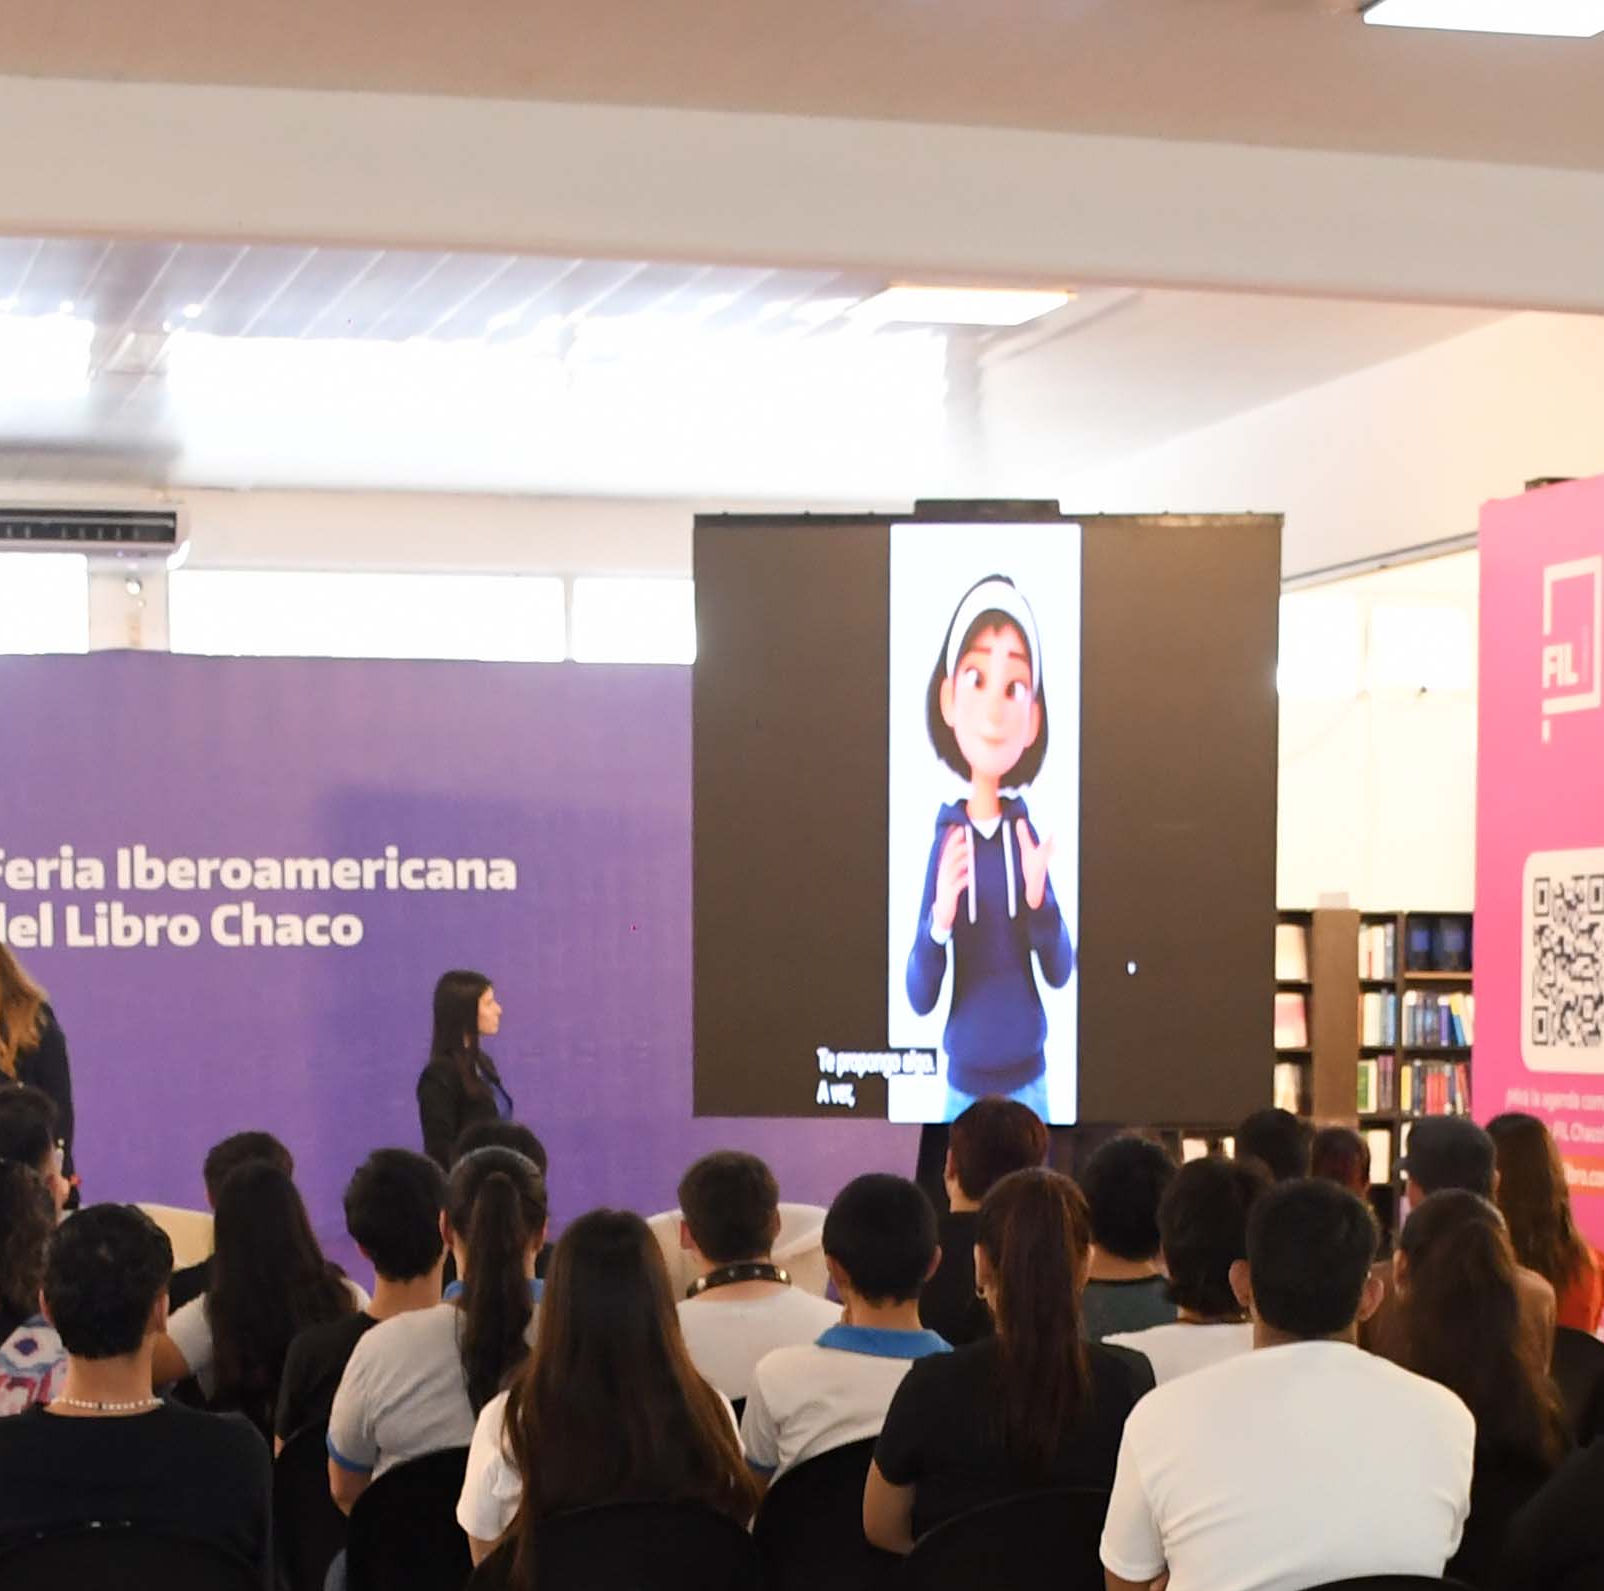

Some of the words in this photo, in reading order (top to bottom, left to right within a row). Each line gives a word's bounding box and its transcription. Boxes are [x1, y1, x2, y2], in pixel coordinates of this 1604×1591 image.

[116, 843, 517, 891] Iberoamericana
[65, 901, 202, 948] Libro
[210, 901, 364, 947] Chaco
